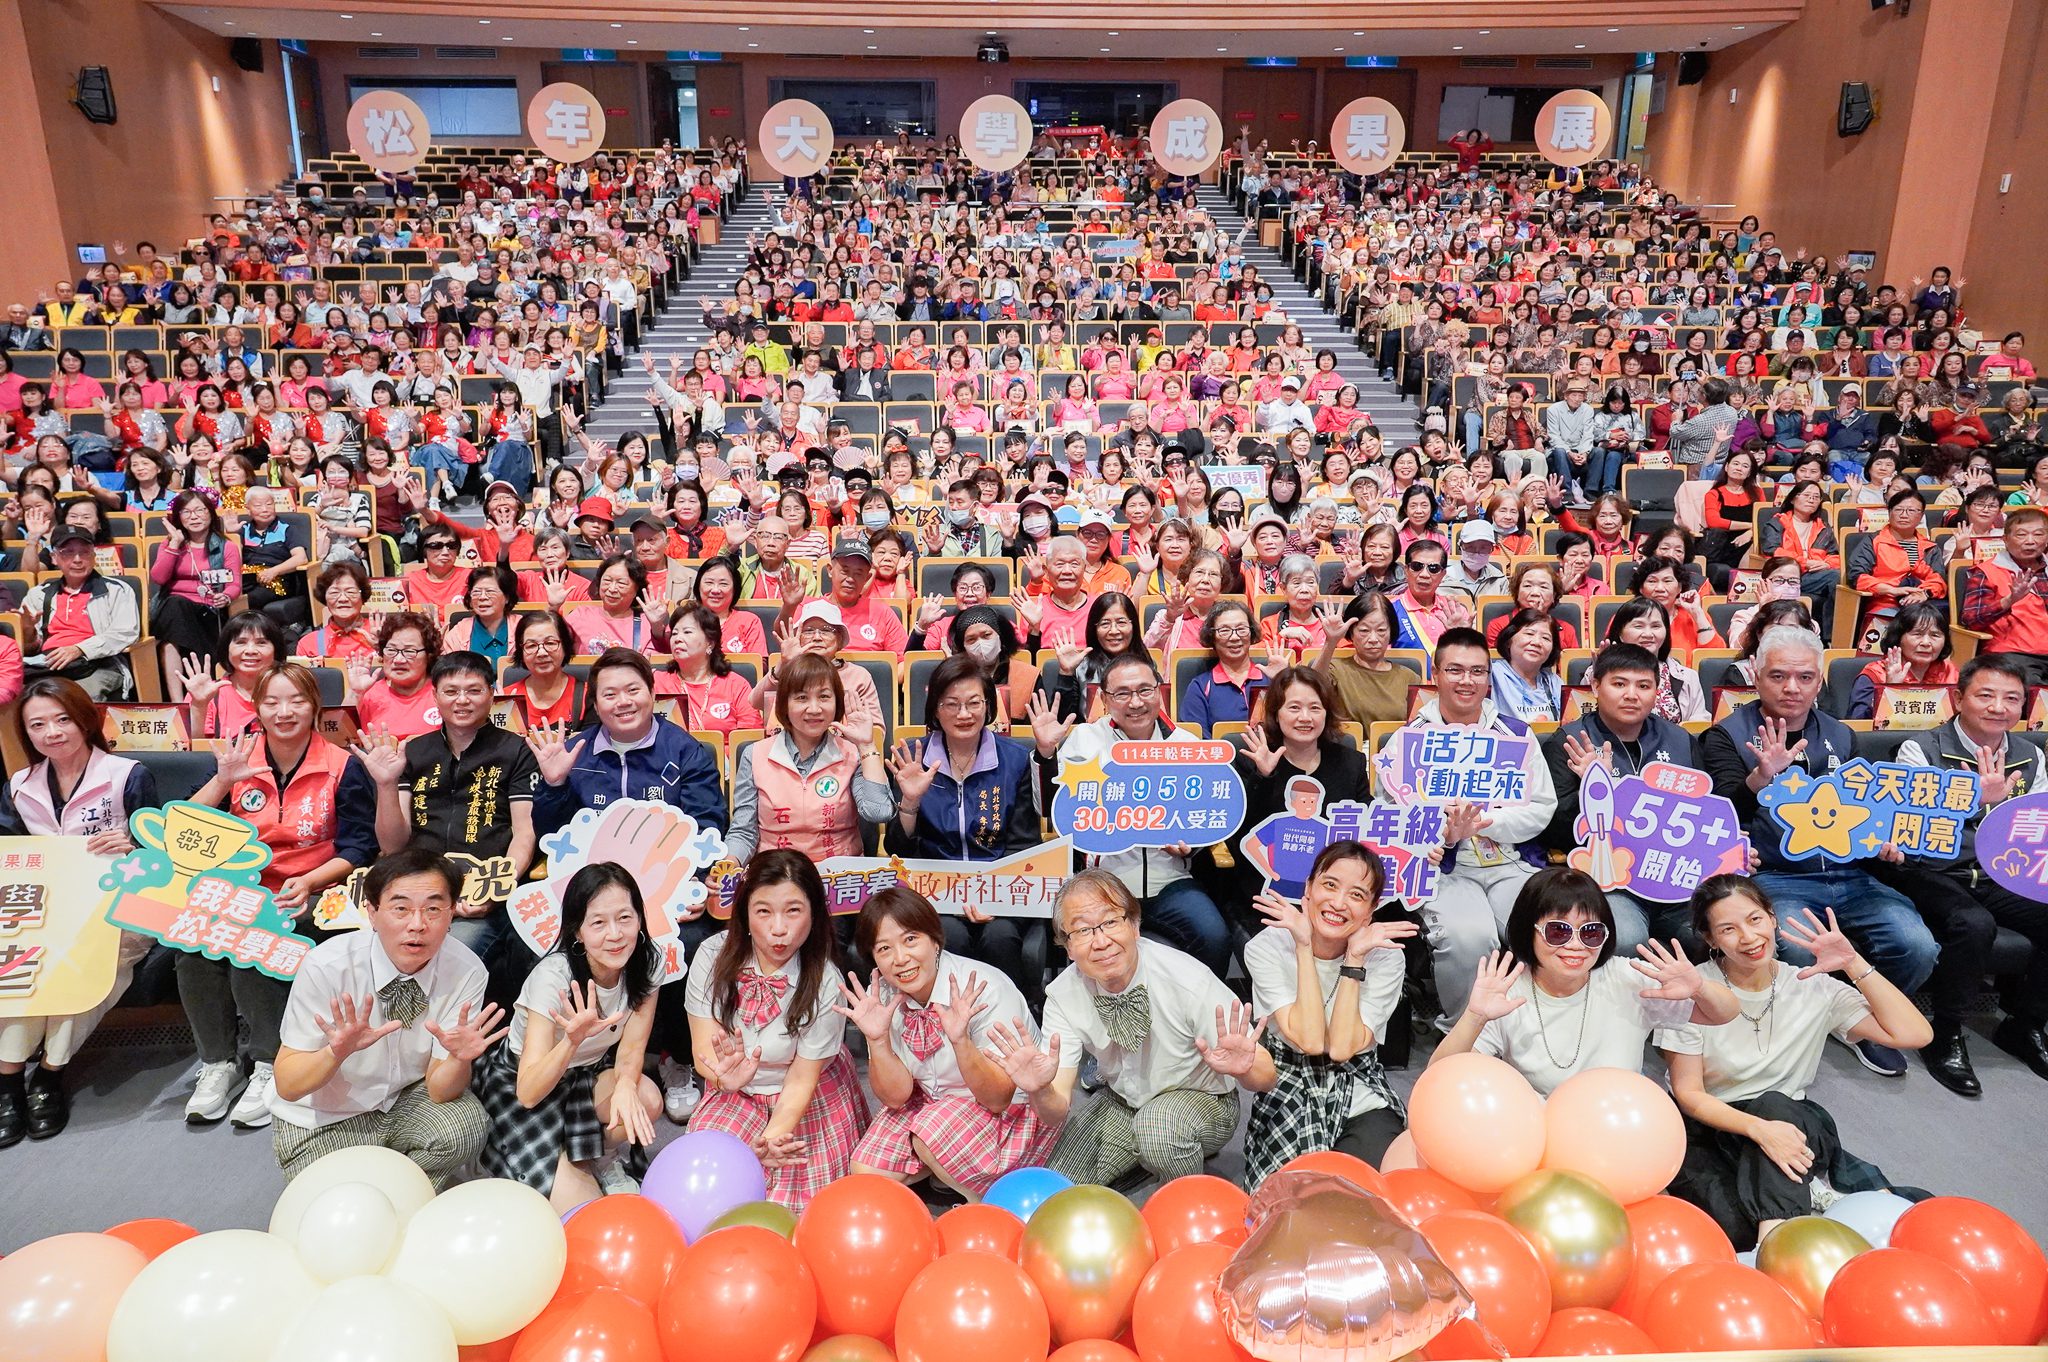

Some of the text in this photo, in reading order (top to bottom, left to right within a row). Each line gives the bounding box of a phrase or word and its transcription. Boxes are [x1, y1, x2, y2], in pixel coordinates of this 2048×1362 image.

[363, 108, 417, 157] 松
[544, 100, 592, 148] 年
[774, 115, 819, 162] 大
[975, 111, 1018, 159] 學
[1164, 116, 1210, 161] 成
[1346, 114, 1389, 160] 果
[1551, 105, 1599, 152] 展
[1211, 470, 1259, 487] 太優秀
[1893, 700, 1937, 715] 貴賓席
[120, 719, 169, 736] 貴賓席
[1122, 746, 1225, 761] 114年松年大學
[1423, 730, 1495, 764] 活力
[429, 763, 442, 788] 主任
[1428, 768, 1526, 799] 動起來
[1655, 768, 1698, 794] 精彩
[1842, 763, 1977, 813] 今天我最
[101, 797, 113, 832] 新北市
[483, 765, 502, 828] 新北市議員
[593, 793, 607, 805] 助
[1283, 832, 1316, 845] 世代同學
[1328, 804, 1443, 846] 高年級
[1625, 792, 1731, 848] 55+
[1890, 811, 1960, 854] 閃亮
[0, 853, 43, 868] 果展
[176, 828, 221, 859] #1
[1281, 842, 1316, 854] 青春不老
[1637, 848, 1703, 890] 開始
[189, 879, 264, 922] 我是
[913, 872, 1064, 907] 政府社會局
[168, 909, 307, 974] 松年學霸
